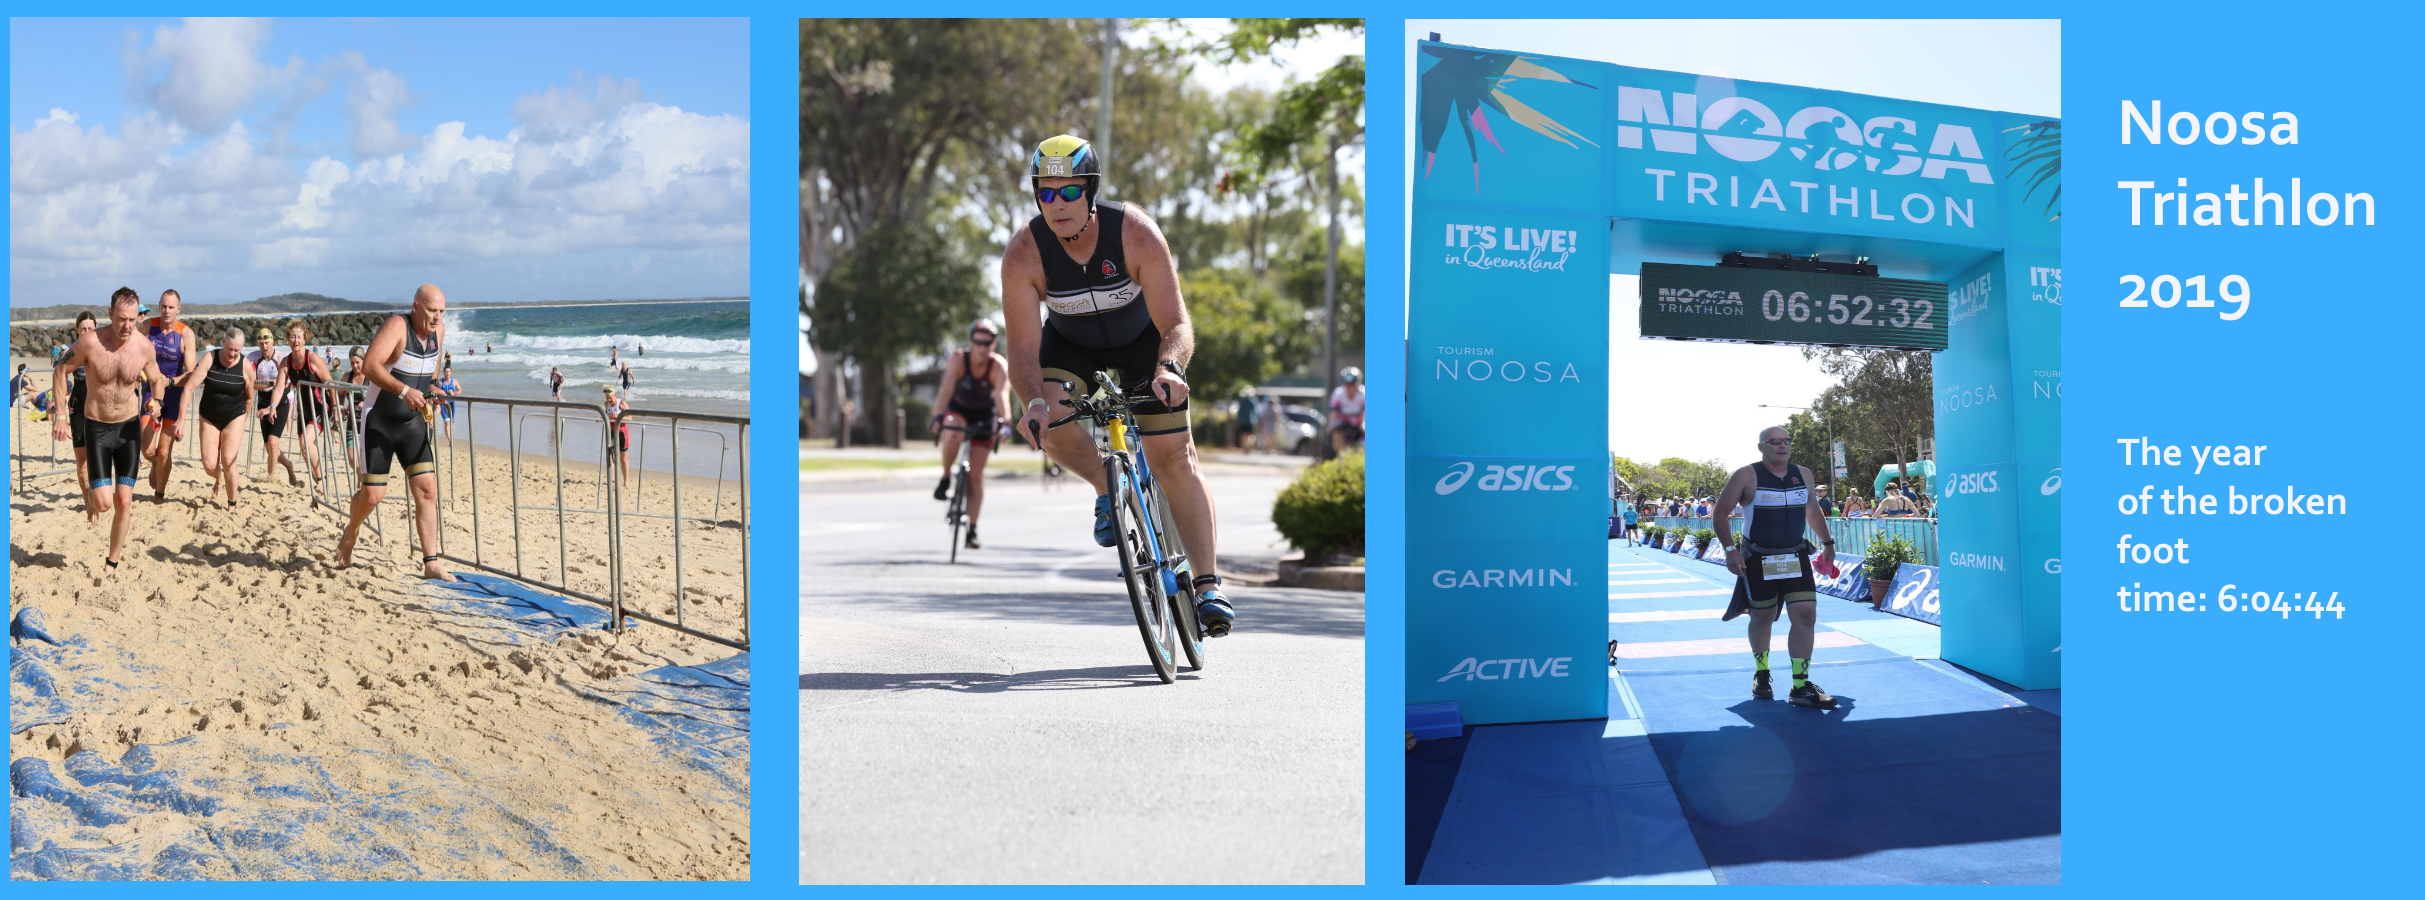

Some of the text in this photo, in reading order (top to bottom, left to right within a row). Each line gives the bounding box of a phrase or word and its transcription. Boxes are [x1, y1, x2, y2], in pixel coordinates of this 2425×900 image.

[1618, 86, 1994, 184] NOOSA
[1046, 164, 1064, 175] 104
[1645, 168, 1974, 228] TRIATHLON
[1446, 223, 1577, 254] IT'S LIVE!
[1445, 244, 1569, 273] in Queensland
[1658, 287, 1743, 306] NOOSA
[1960, 272, 1992, 305] LIVE!
[2032, 291, 2044, 302] in
[1659, 303, 1744, 316] TRIATHLON
[1761, 289, 1934, 329] 06:52:32
[1437, 346, 1494, 356] TOURISM
[1436, 358, 1581, 384] NOOSA
[1939, 384, 1997, 415] NOOSA
[1949, 551, 2004, 572] GARMIN
[1432, 567, 1572, 589] GARMIN
[1436, 656, 1573, 683] ACTIVE
